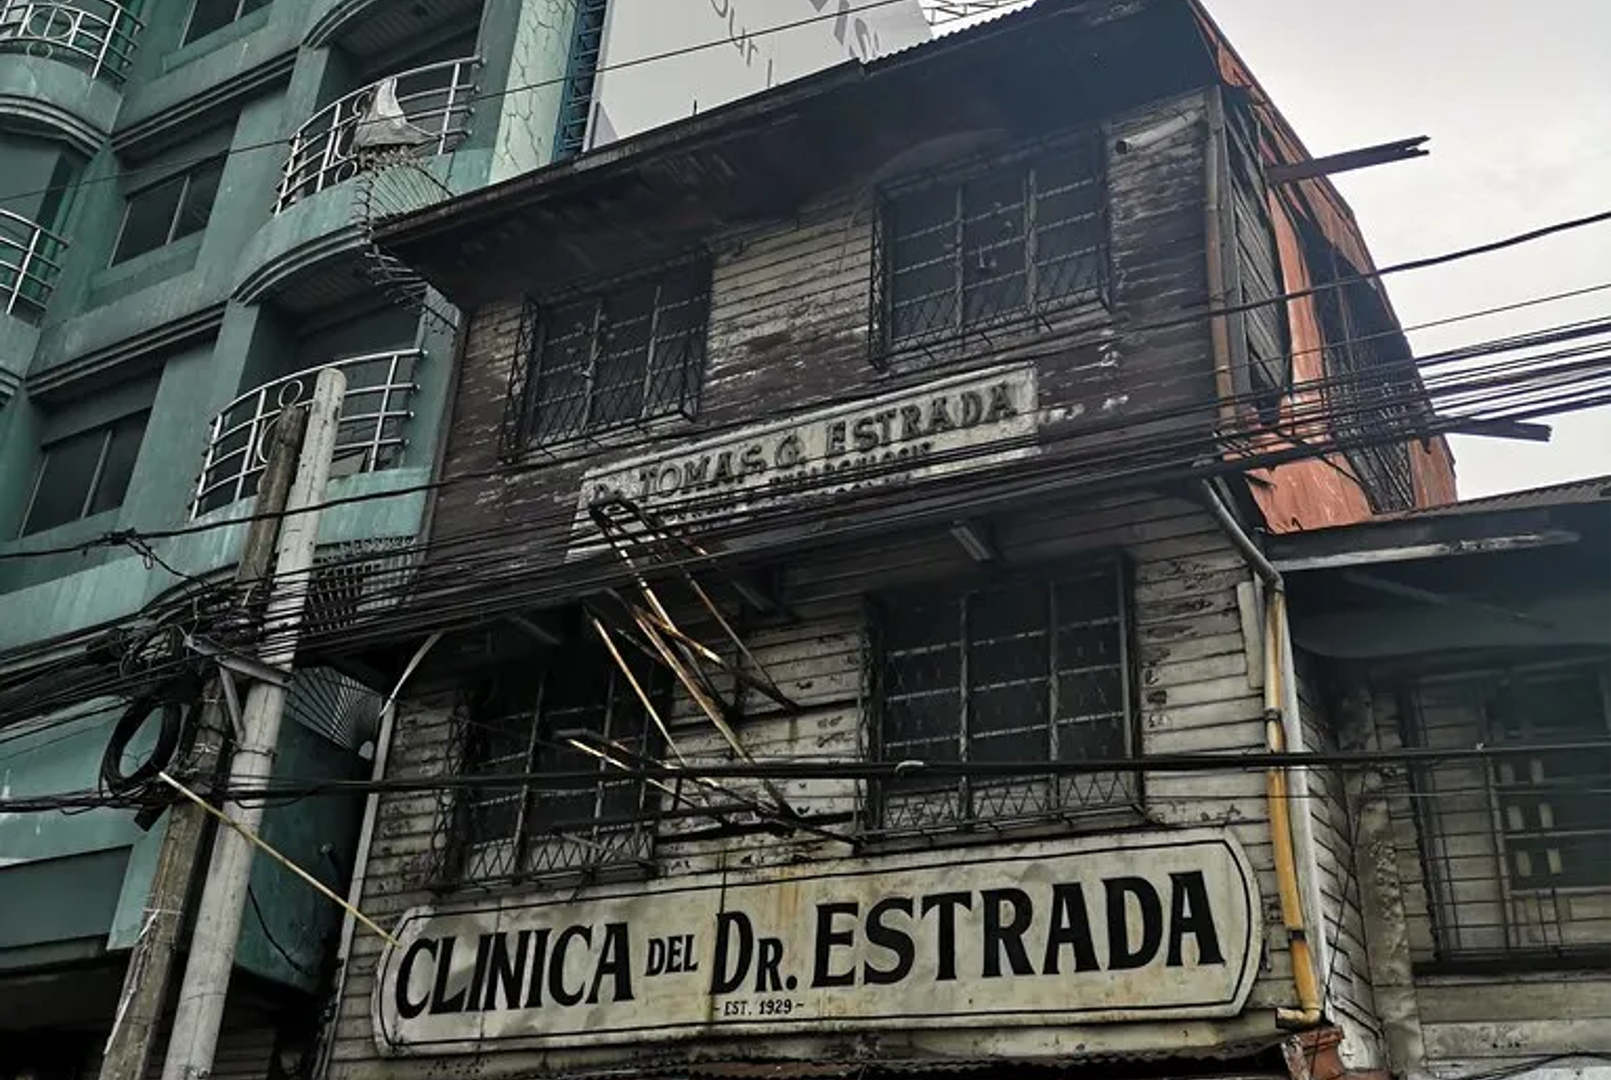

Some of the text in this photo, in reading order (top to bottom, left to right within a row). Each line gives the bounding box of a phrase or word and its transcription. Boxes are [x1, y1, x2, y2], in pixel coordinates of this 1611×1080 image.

[639, 444, 767, 502] TOMAS
[824, 382, 1018, 460] ESTRADA
[395, 870, 1226, 1019] CLINICA DEL DR. ESTRADA
[723, 998, 792, 1016] EST. 1929
